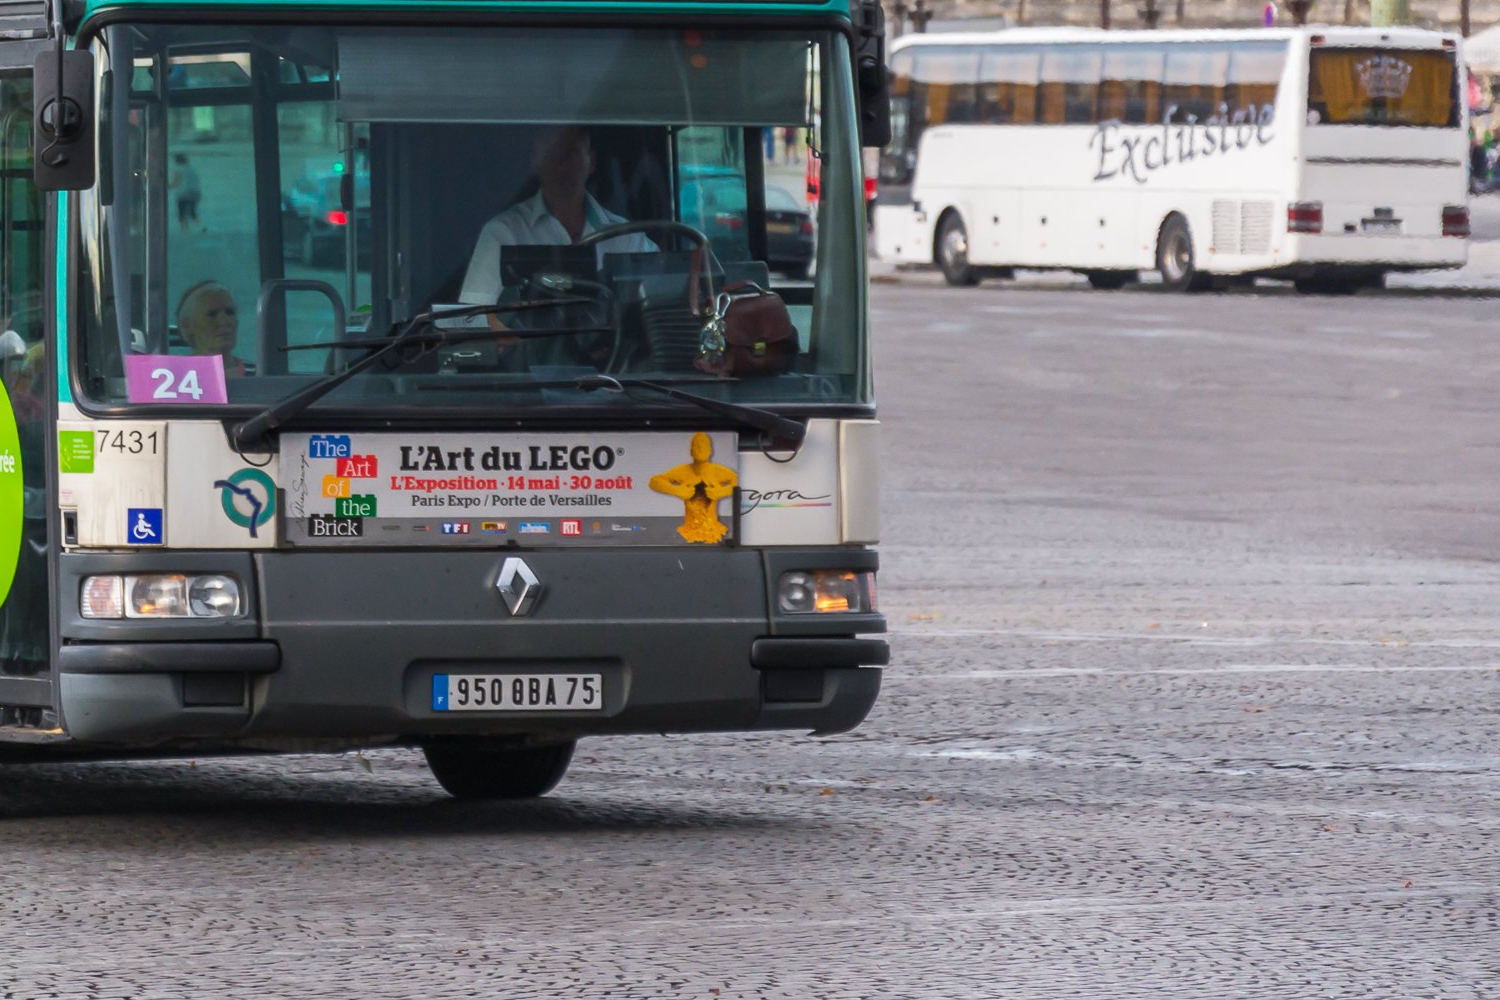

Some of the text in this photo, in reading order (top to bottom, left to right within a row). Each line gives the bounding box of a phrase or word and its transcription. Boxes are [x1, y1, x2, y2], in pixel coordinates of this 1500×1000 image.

[1089, 101, 1275, 184] Exclusive
[151, 368, 203, 400] 24
[97, 430, 158, 454] 7431
[312, 440, 347, 457] The
[400, 446, 475, 471] L'Art
[481, 446, 522, 471] du
[343, 461, 371, 477] Art
[327, 480, 345, 496] of
[391, 476, 633, 493] L'Exposition 14 mai 30 août
[343, 500, 370, 516] the
[412, 495, 445, 507] Paris
[448, 495, 481, 510] Expo
[492, 495, 527, 507] Porte
[529, 495, 546, 507] de
[549, 494, 612, 507] Versailles
[741, 488, 831, 516] gora
[314, 519, 358, 536] Brick
[562, 521, 581, 535] RTL
[457, 677, 595, 706] 950 QBA 75
[437, 696, 444, 705] F
